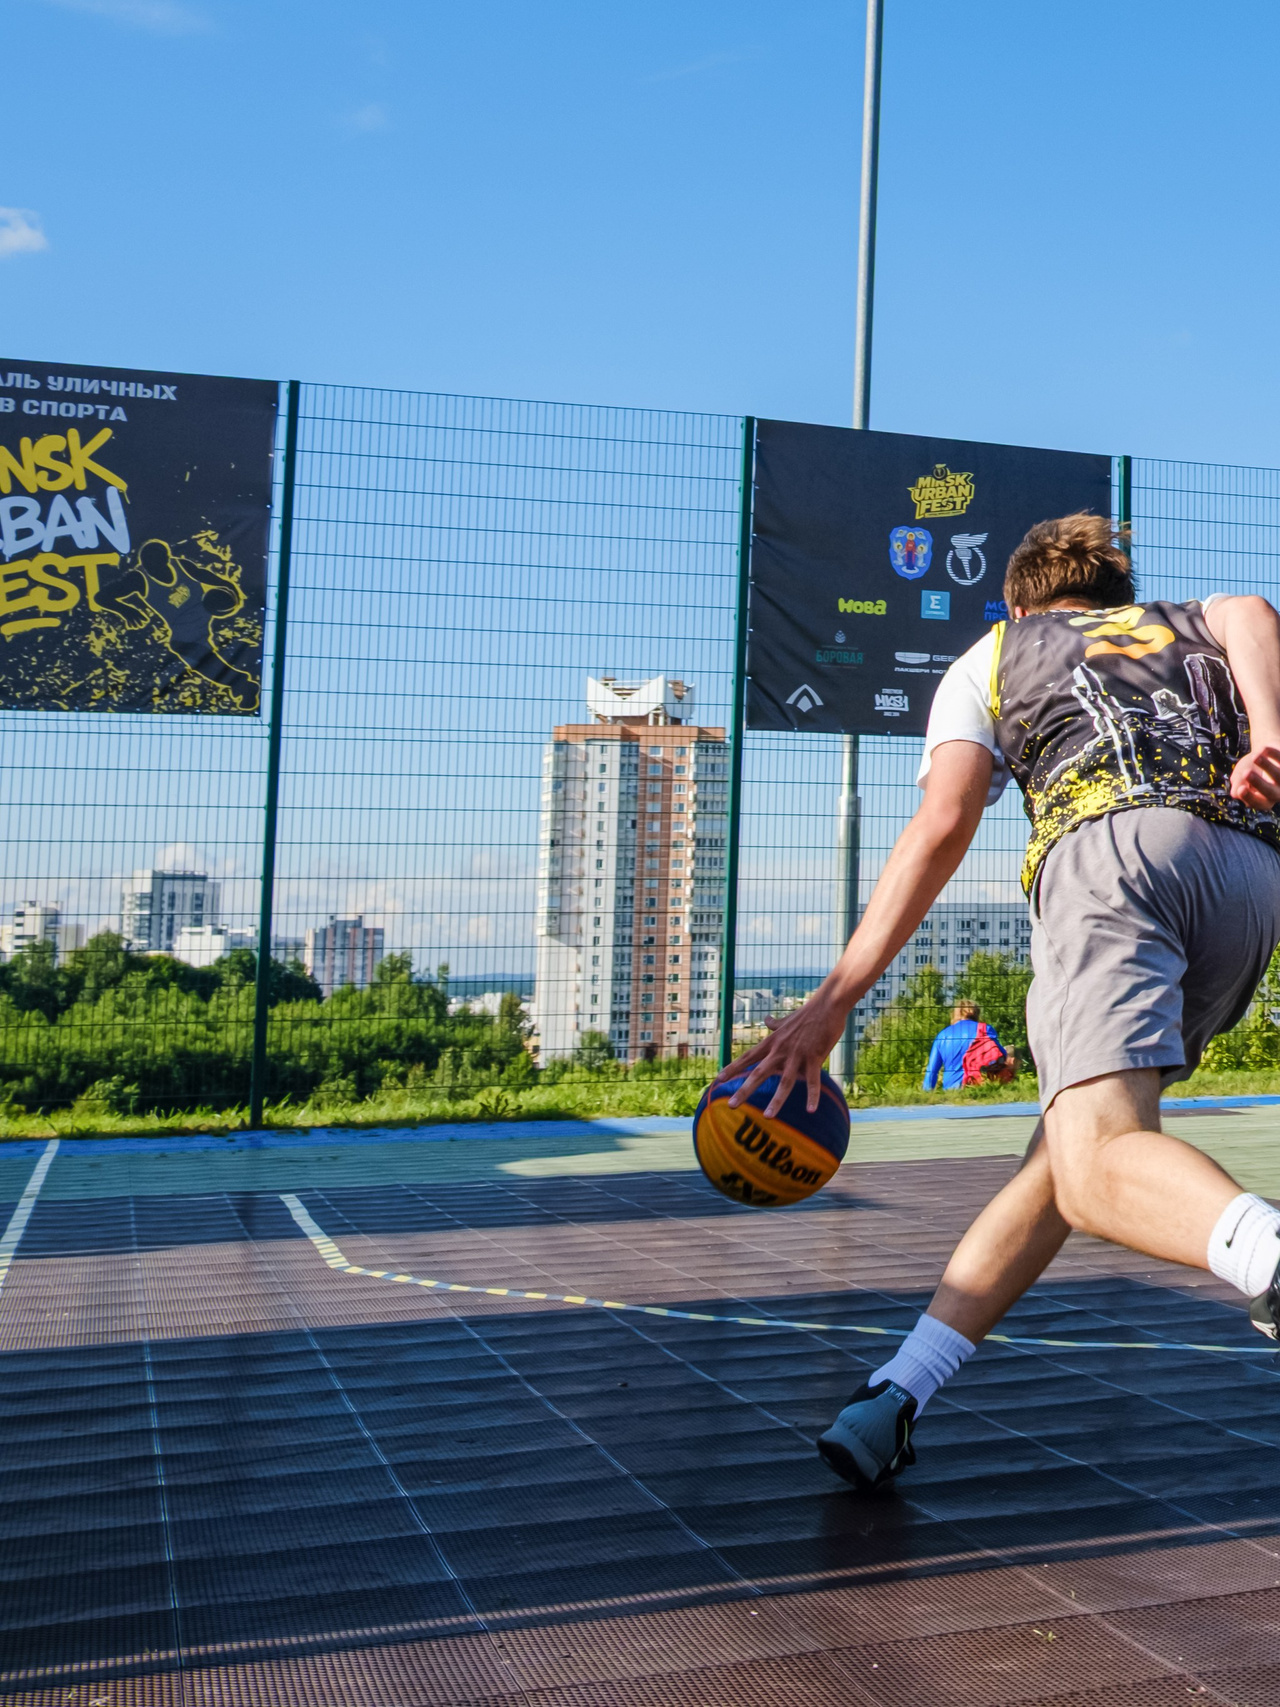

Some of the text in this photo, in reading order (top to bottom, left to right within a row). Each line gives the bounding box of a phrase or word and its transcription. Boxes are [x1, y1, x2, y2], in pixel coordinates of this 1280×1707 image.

[0, 372, 178, 401] ЛЬ УЛИЧНЫХ
[22, 399, 128, 422] СПОРТА
[914, 485, 971, 501] URBAN
[919, 497, 966, 515] FEST
[0, 486, 131, 554] BAN
[815, 650, 864, 664] БОРОВАЯ
[735, 1115, 822, 1185] Wilson
